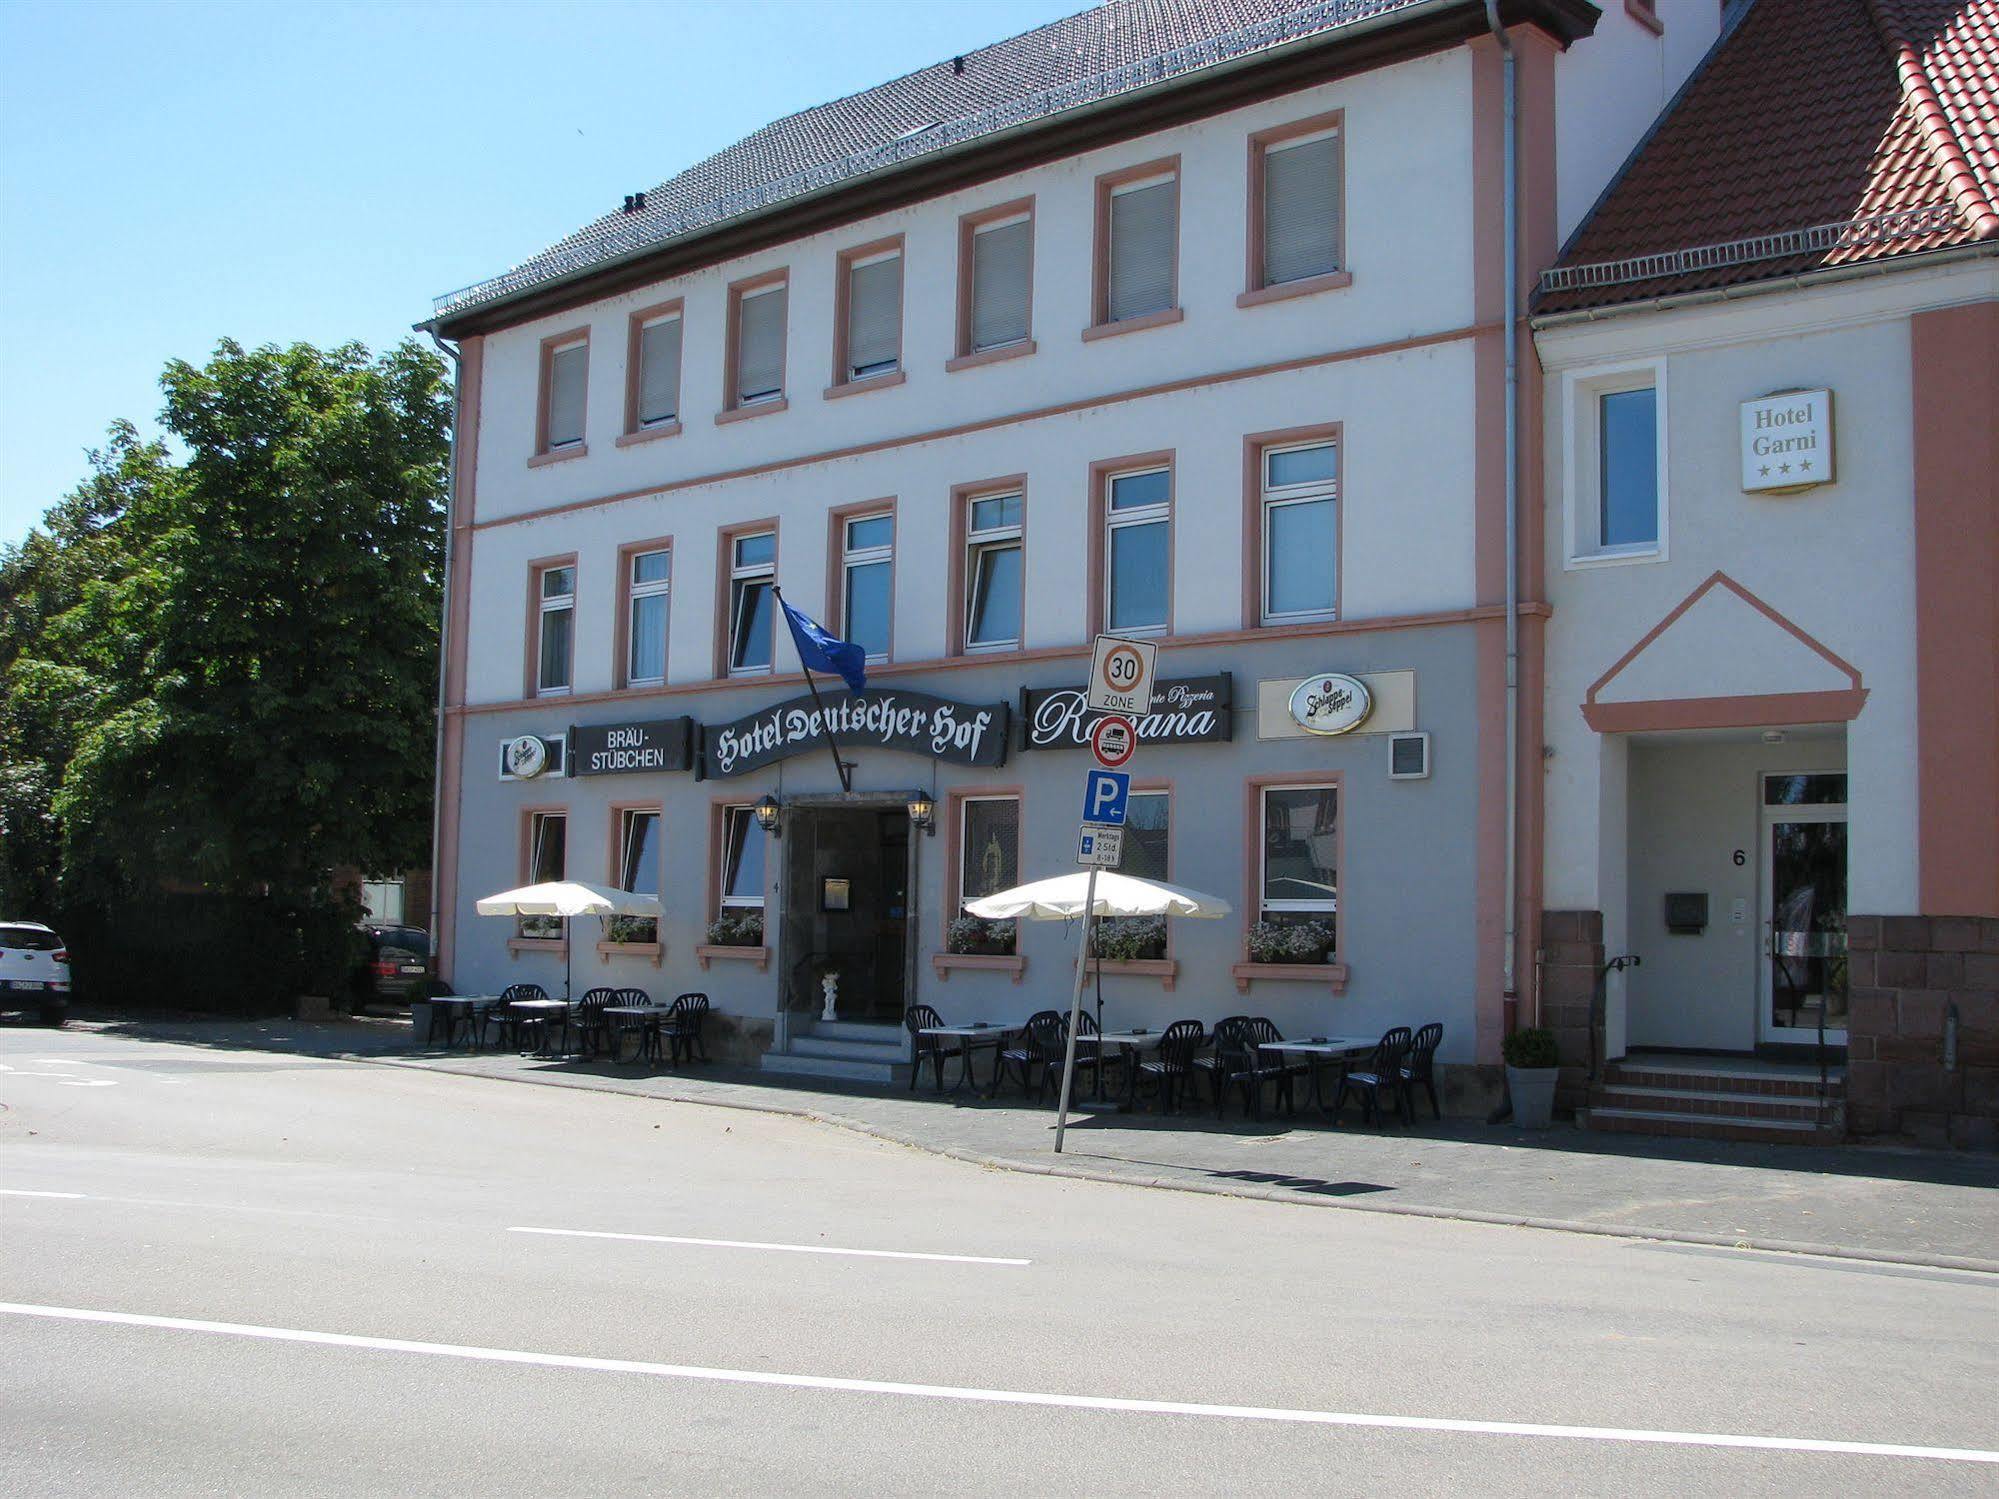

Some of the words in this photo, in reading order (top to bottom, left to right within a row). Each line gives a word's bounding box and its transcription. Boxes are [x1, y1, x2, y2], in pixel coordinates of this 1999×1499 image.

[1753, 403, 1813, 430] Hotel
[1753, 430, 1817, 457] Garni
[1111, 657, 1136, 680] 30
[1103, 694, 1135, 709] ZONE
[1167, 685, 1214, 709] Pizzeria
[1032, 691, 1216, 745] Roana
[607, 728, 650, 749] BRÄU-
[717, 709, 784, 773] Hotel
[786, 697, 927, 743] Deutscher
[929, 705, 992, 762] Hof
[591, 748, 664, 770] STÜBCHEN
[1093, 777, 1119, 816] P
[1733, 849, 1746, 866] 6
